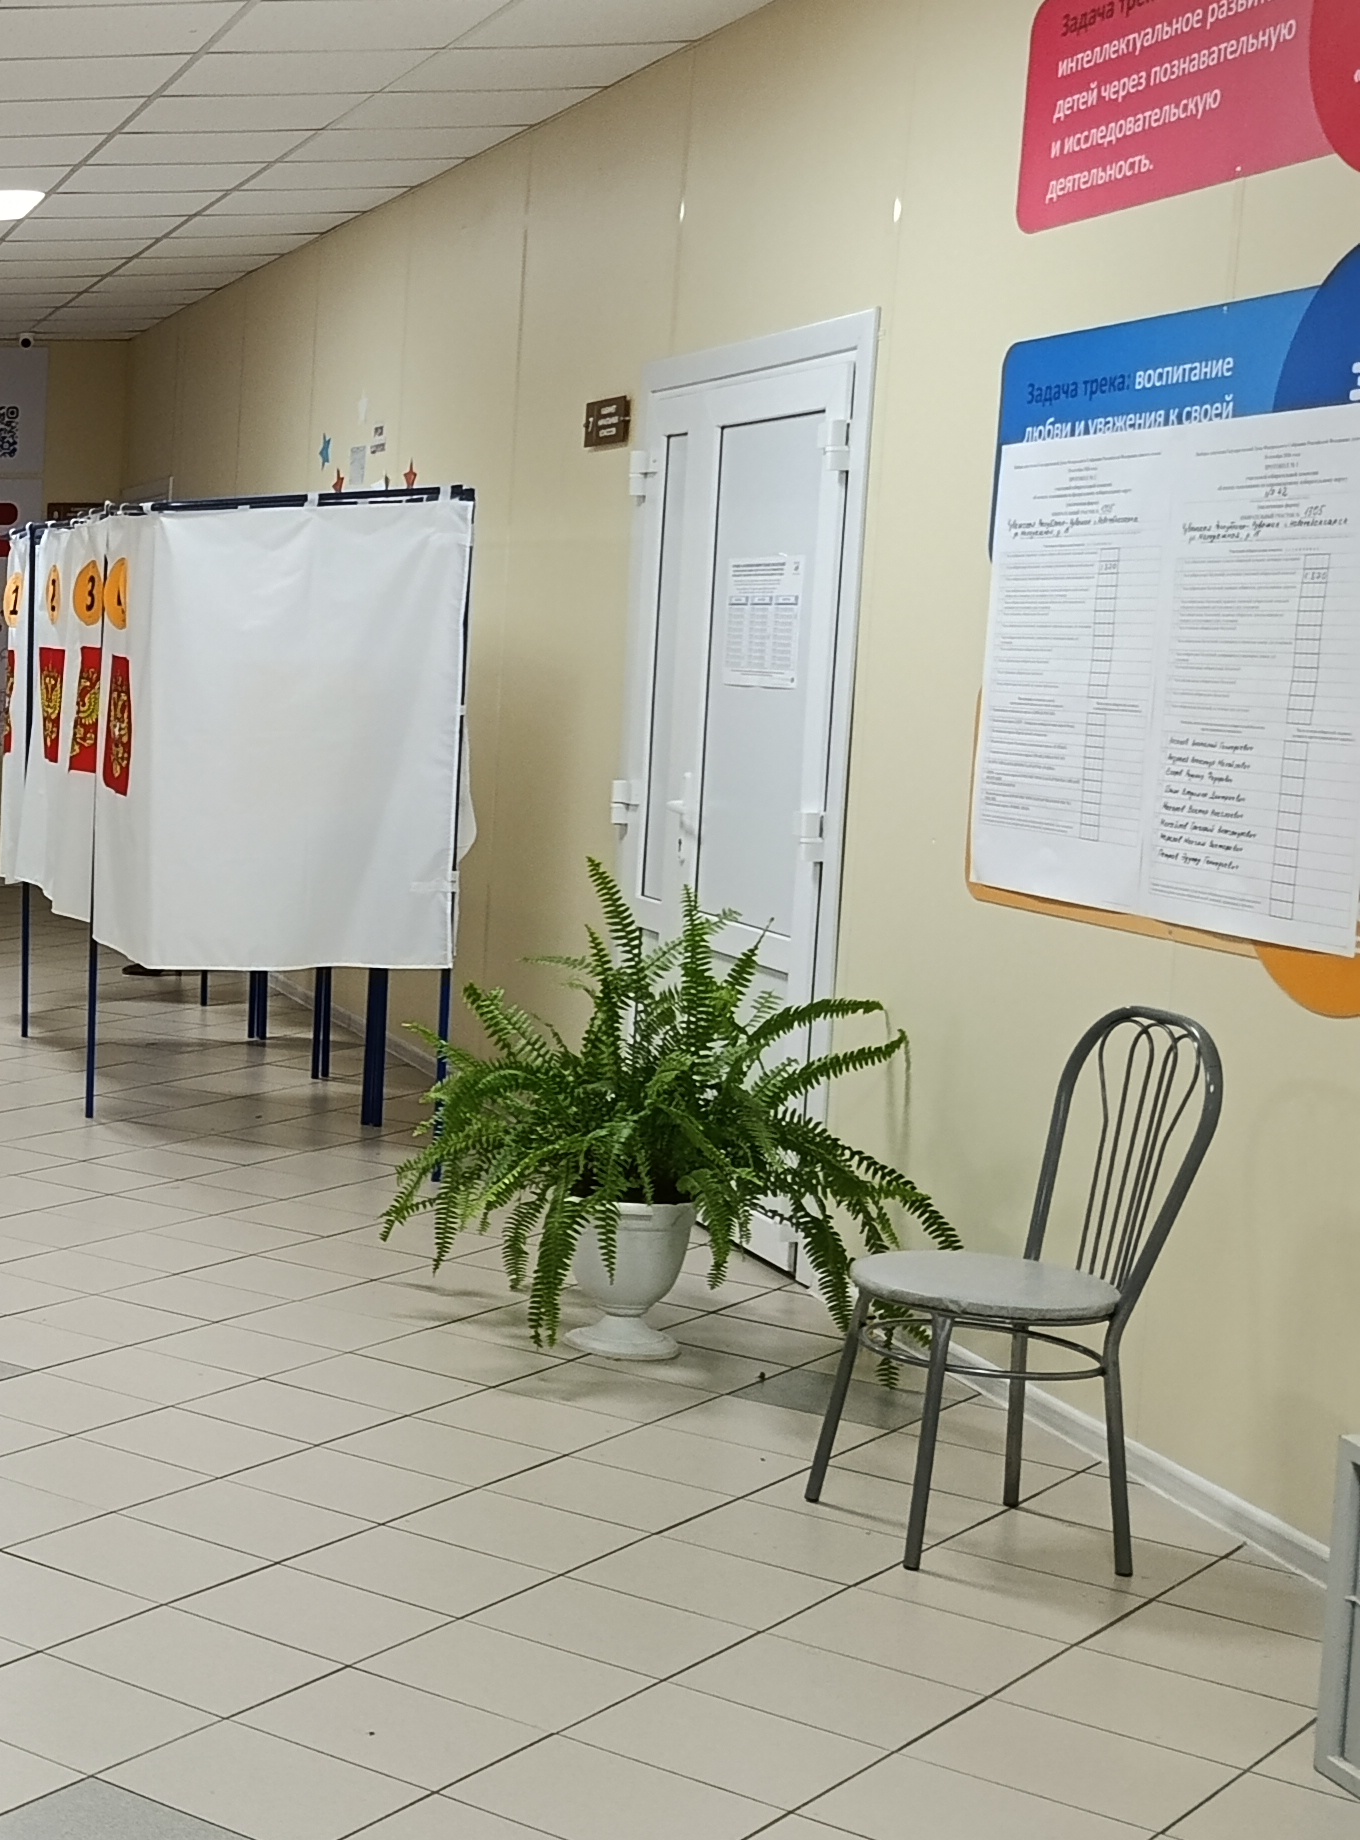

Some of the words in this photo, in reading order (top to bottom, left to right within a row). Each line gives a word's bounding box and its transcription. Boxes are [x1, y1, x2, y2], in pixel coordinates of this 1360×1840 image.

[1058, 8, 1203, 78] интеллектуальное
[1062, 0, 1115, 37] Задача
[1053, 81, 1098, 124] детей
[1102, 73, 1146, 108] через
[1150, 19, 1296, 87] познавательную
[1050, 140, 1060, 159] и
[1064, 88, 1221, 154] исследовательскую
[1046, 153, 1154, 204] деятельность.
[1026, 377, 1078, 406] Задача
[1082, 374, 1130, 401] трека:
[1134, 356, 1234, 391] воспитание
[1022, 417, 1071, 443] любви
[1074, 421, 1085, 437] и
[1088, 411, 1164, 435] уважения
[1169, 408, 1179, 426] к
[1182, 394, 1234, 425] своей
[10, 586, 18, 615] 1
[86, 575, 95, 612] 3
